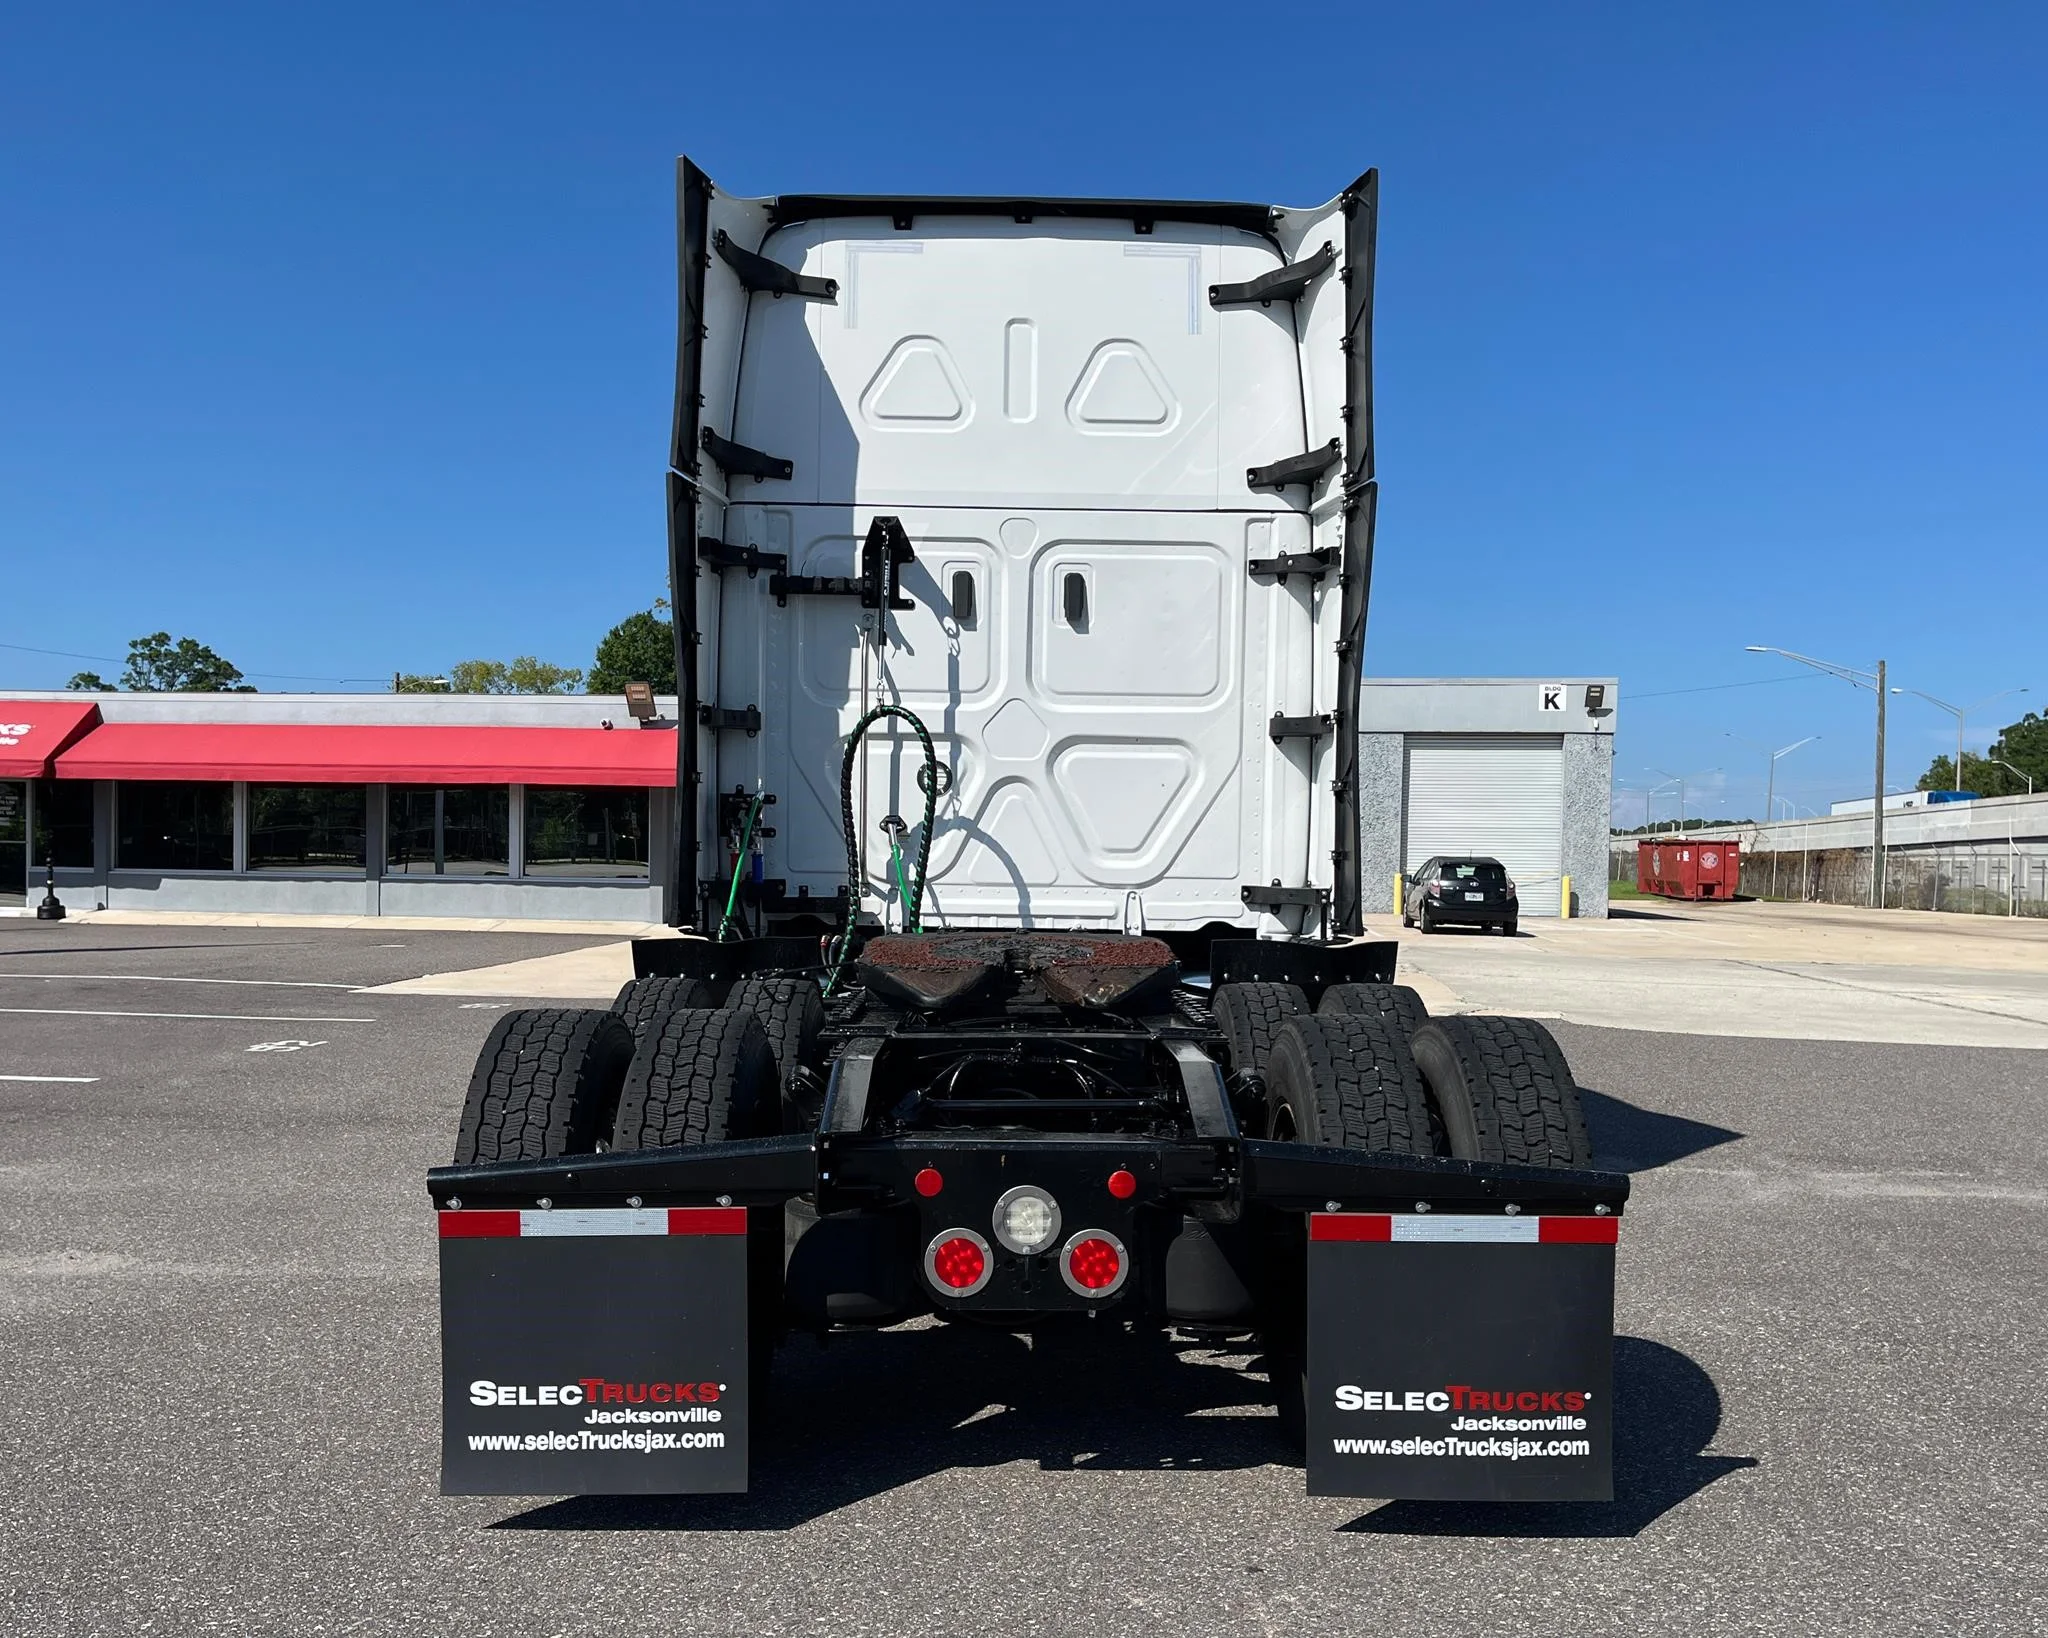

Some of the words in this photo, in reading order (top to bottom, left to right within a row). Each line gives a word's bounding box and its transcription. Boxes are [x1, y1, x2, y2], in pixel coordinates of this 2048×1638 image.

[1544, 692, 1561, 710] K
[584, 1408, 722, 1424] Jacksonville
[1450, 1416, 1587, 1431] Jacksonville
[468, 1430, 725, 1453] www.selecTrucksjax.com
[1333, 1436, 1590, 1461] www.selecTrucksjax.com
